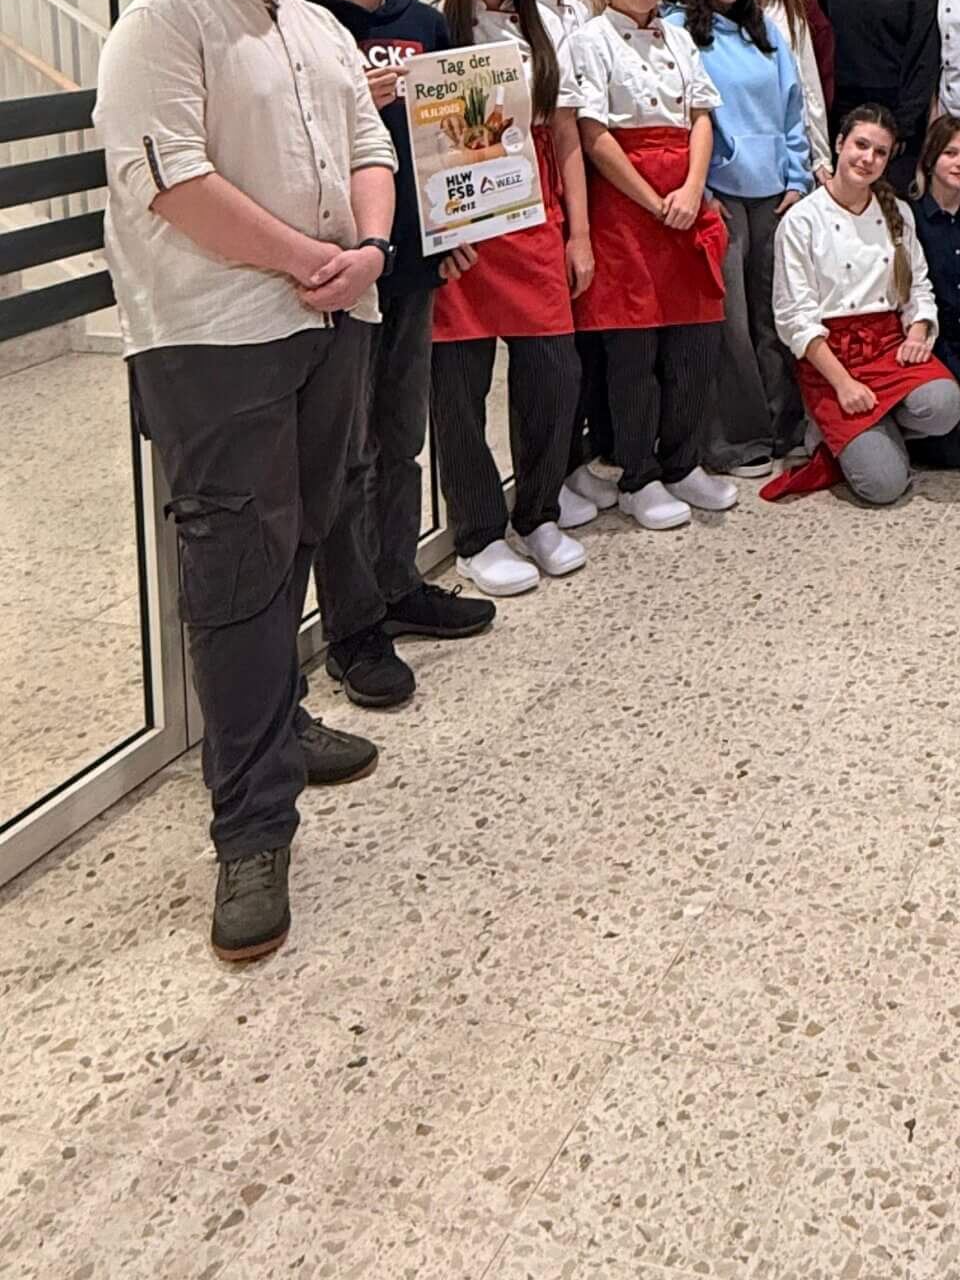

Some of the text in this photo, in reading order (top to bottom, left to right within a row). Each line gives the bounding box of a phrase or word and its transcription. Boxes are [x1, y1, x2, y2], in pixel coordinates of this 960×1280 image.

[437, 53, 491, 76] Tag der
[445, 170, 472, 188] HLW
[447, 183, 475, 200] FSB
